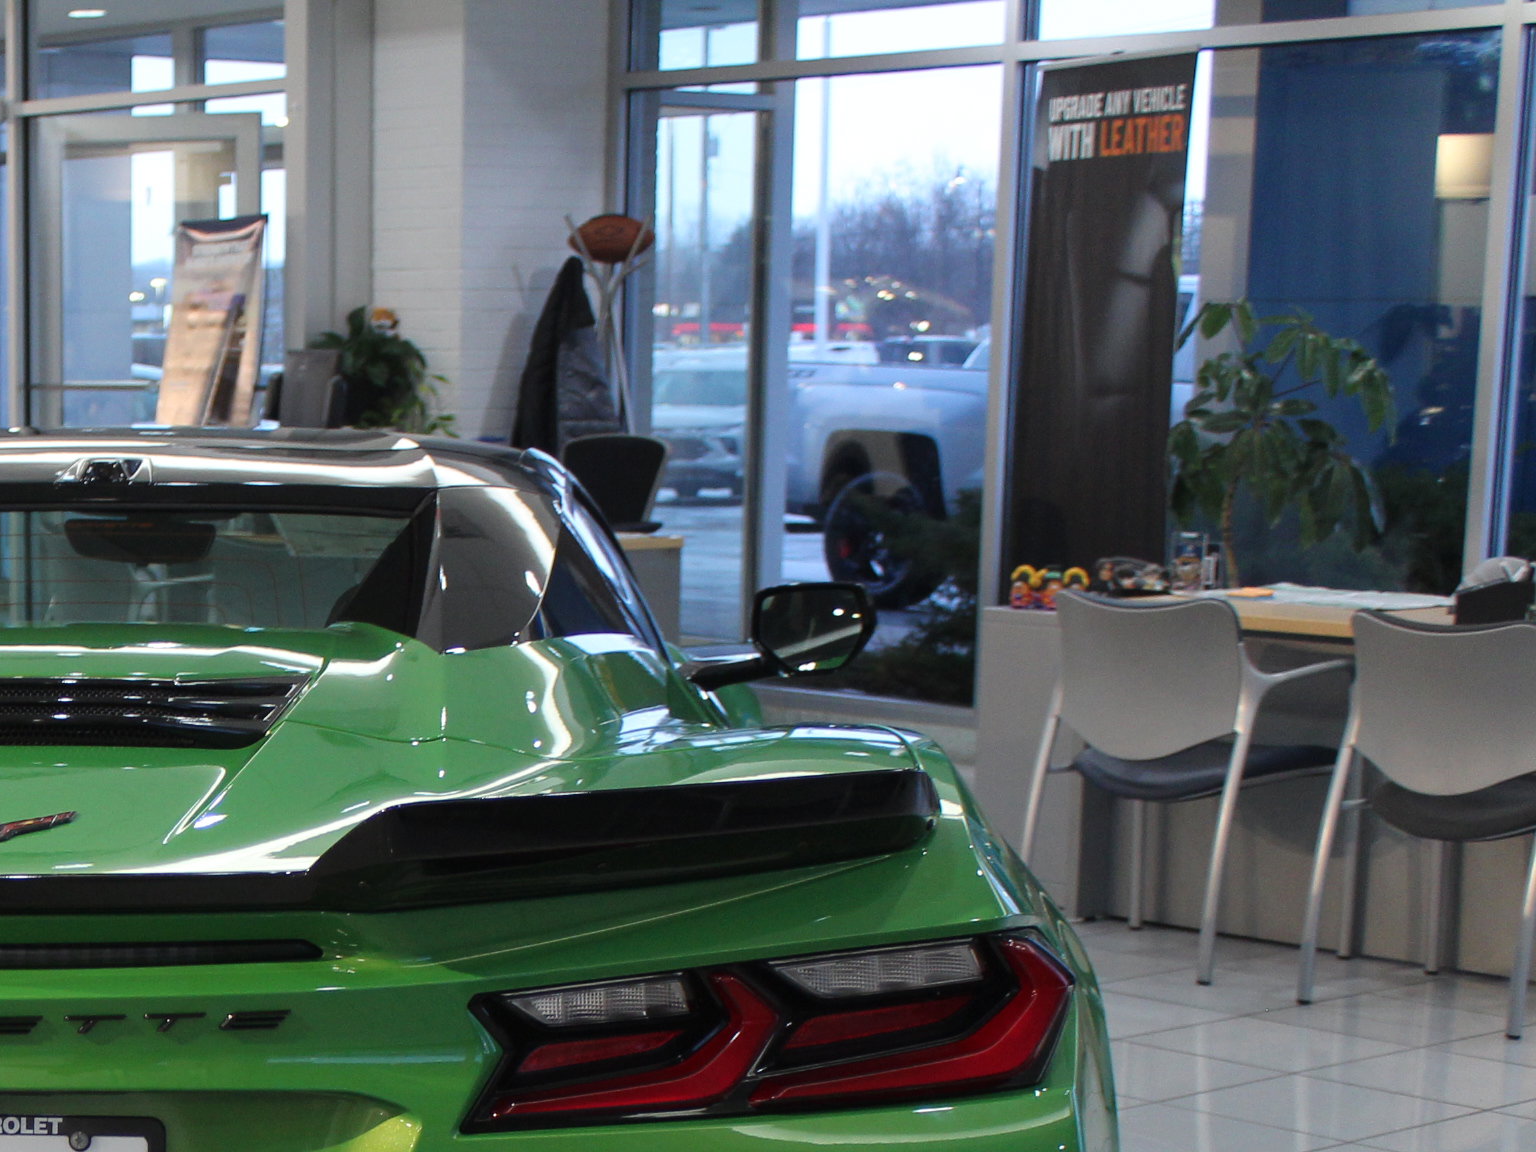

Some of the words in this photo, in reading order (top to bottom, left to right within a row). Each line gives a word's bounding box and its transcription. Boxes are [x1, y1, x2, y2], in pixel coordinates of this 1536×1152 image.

[1049, 93, 1105, 122] UPGRADE
[1105, 90, 1131, 116] ANY
[1133, 84, 1187, 113] VEHICLE
[1048, 121, 1096, 162] WITH
[1099, 114, 1185, 156] LEATHER
